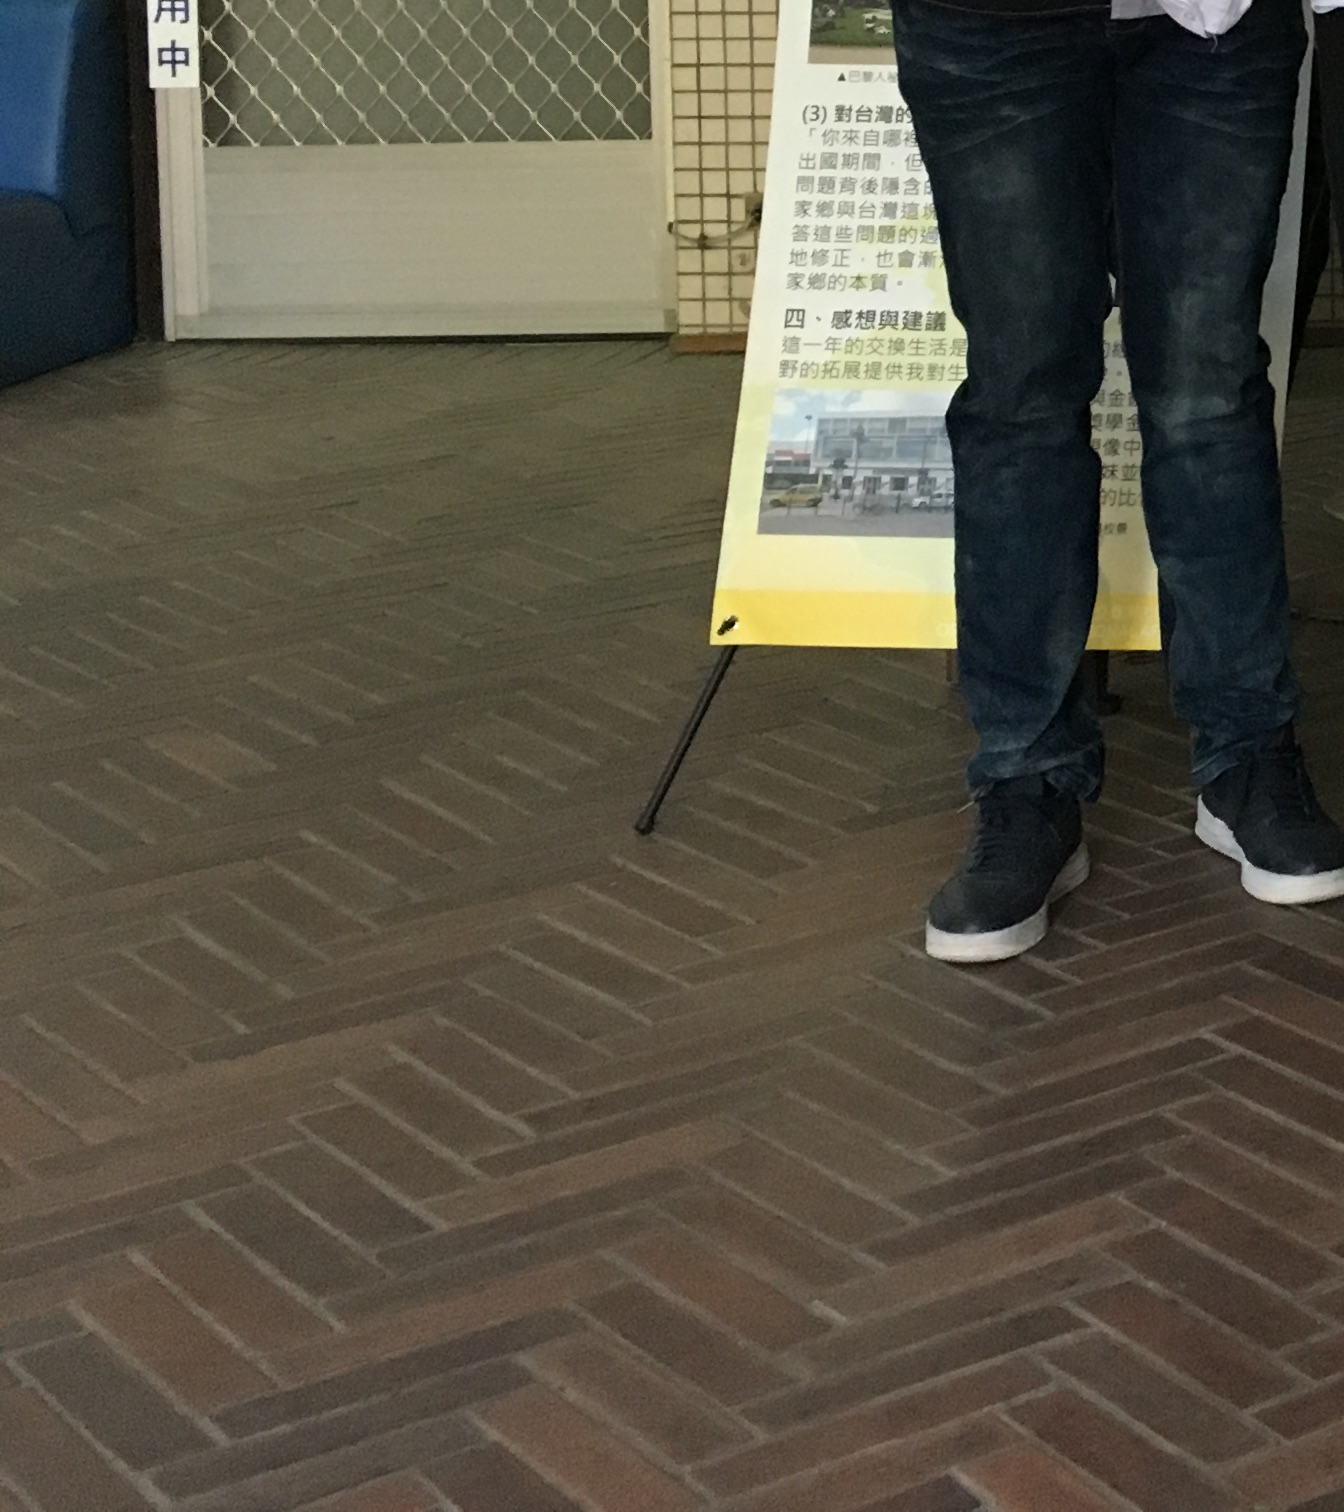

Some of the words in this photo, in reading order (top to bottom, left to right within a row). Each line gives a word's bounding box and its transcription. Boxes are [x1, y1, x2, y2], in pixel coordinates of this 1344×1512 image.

[802, 104, 828, 125] (3)
[788, 248, 946, 269] 地修正，也會漸
[783, 308, 948, 332] 四、感想與建議
[781, 336, 968, 357] 這一年的交換生活是
[778, 359, 968, 382] 野的拓展提供我對生
